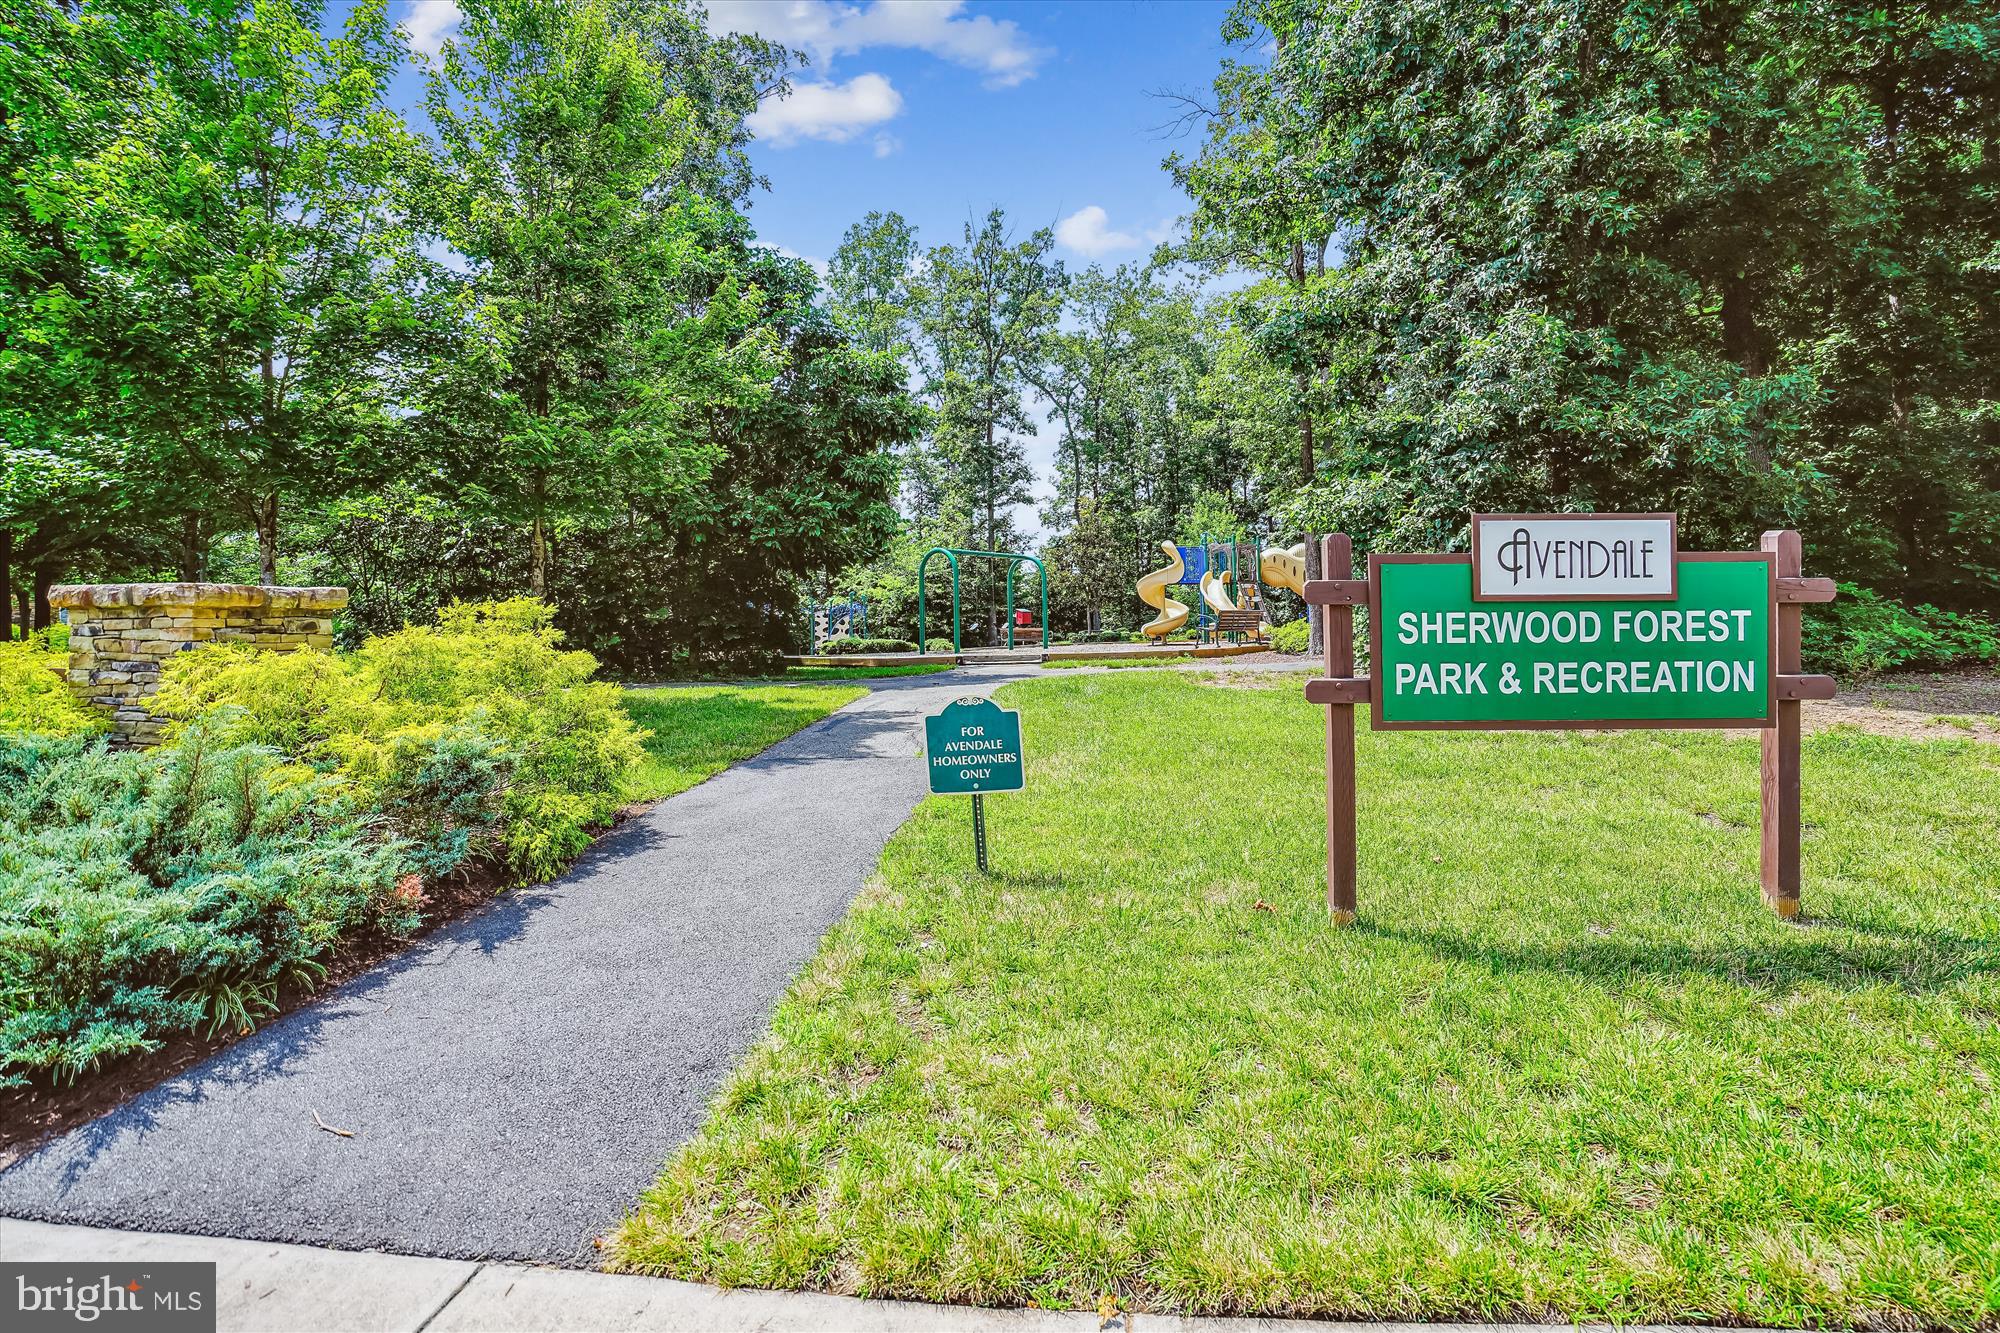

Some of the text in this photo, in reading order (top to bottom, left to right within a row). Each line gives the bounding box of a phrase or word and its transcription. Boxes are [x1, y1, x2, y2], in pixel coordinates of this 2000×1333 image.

[1497, 528, 1653, 586] AVENDALE
[1397, 609, 1752, 644] SHERWOOD FOREST
[1395, 660, 1755, 695] PARK & RECREATION
[961, 726, 984, 737] FOR
[945, 739, 1003, 752] AVENDALE
[933, 752, 1017, 767] HOMEOWNERS
[960, 768, 991, 780] ONLY
